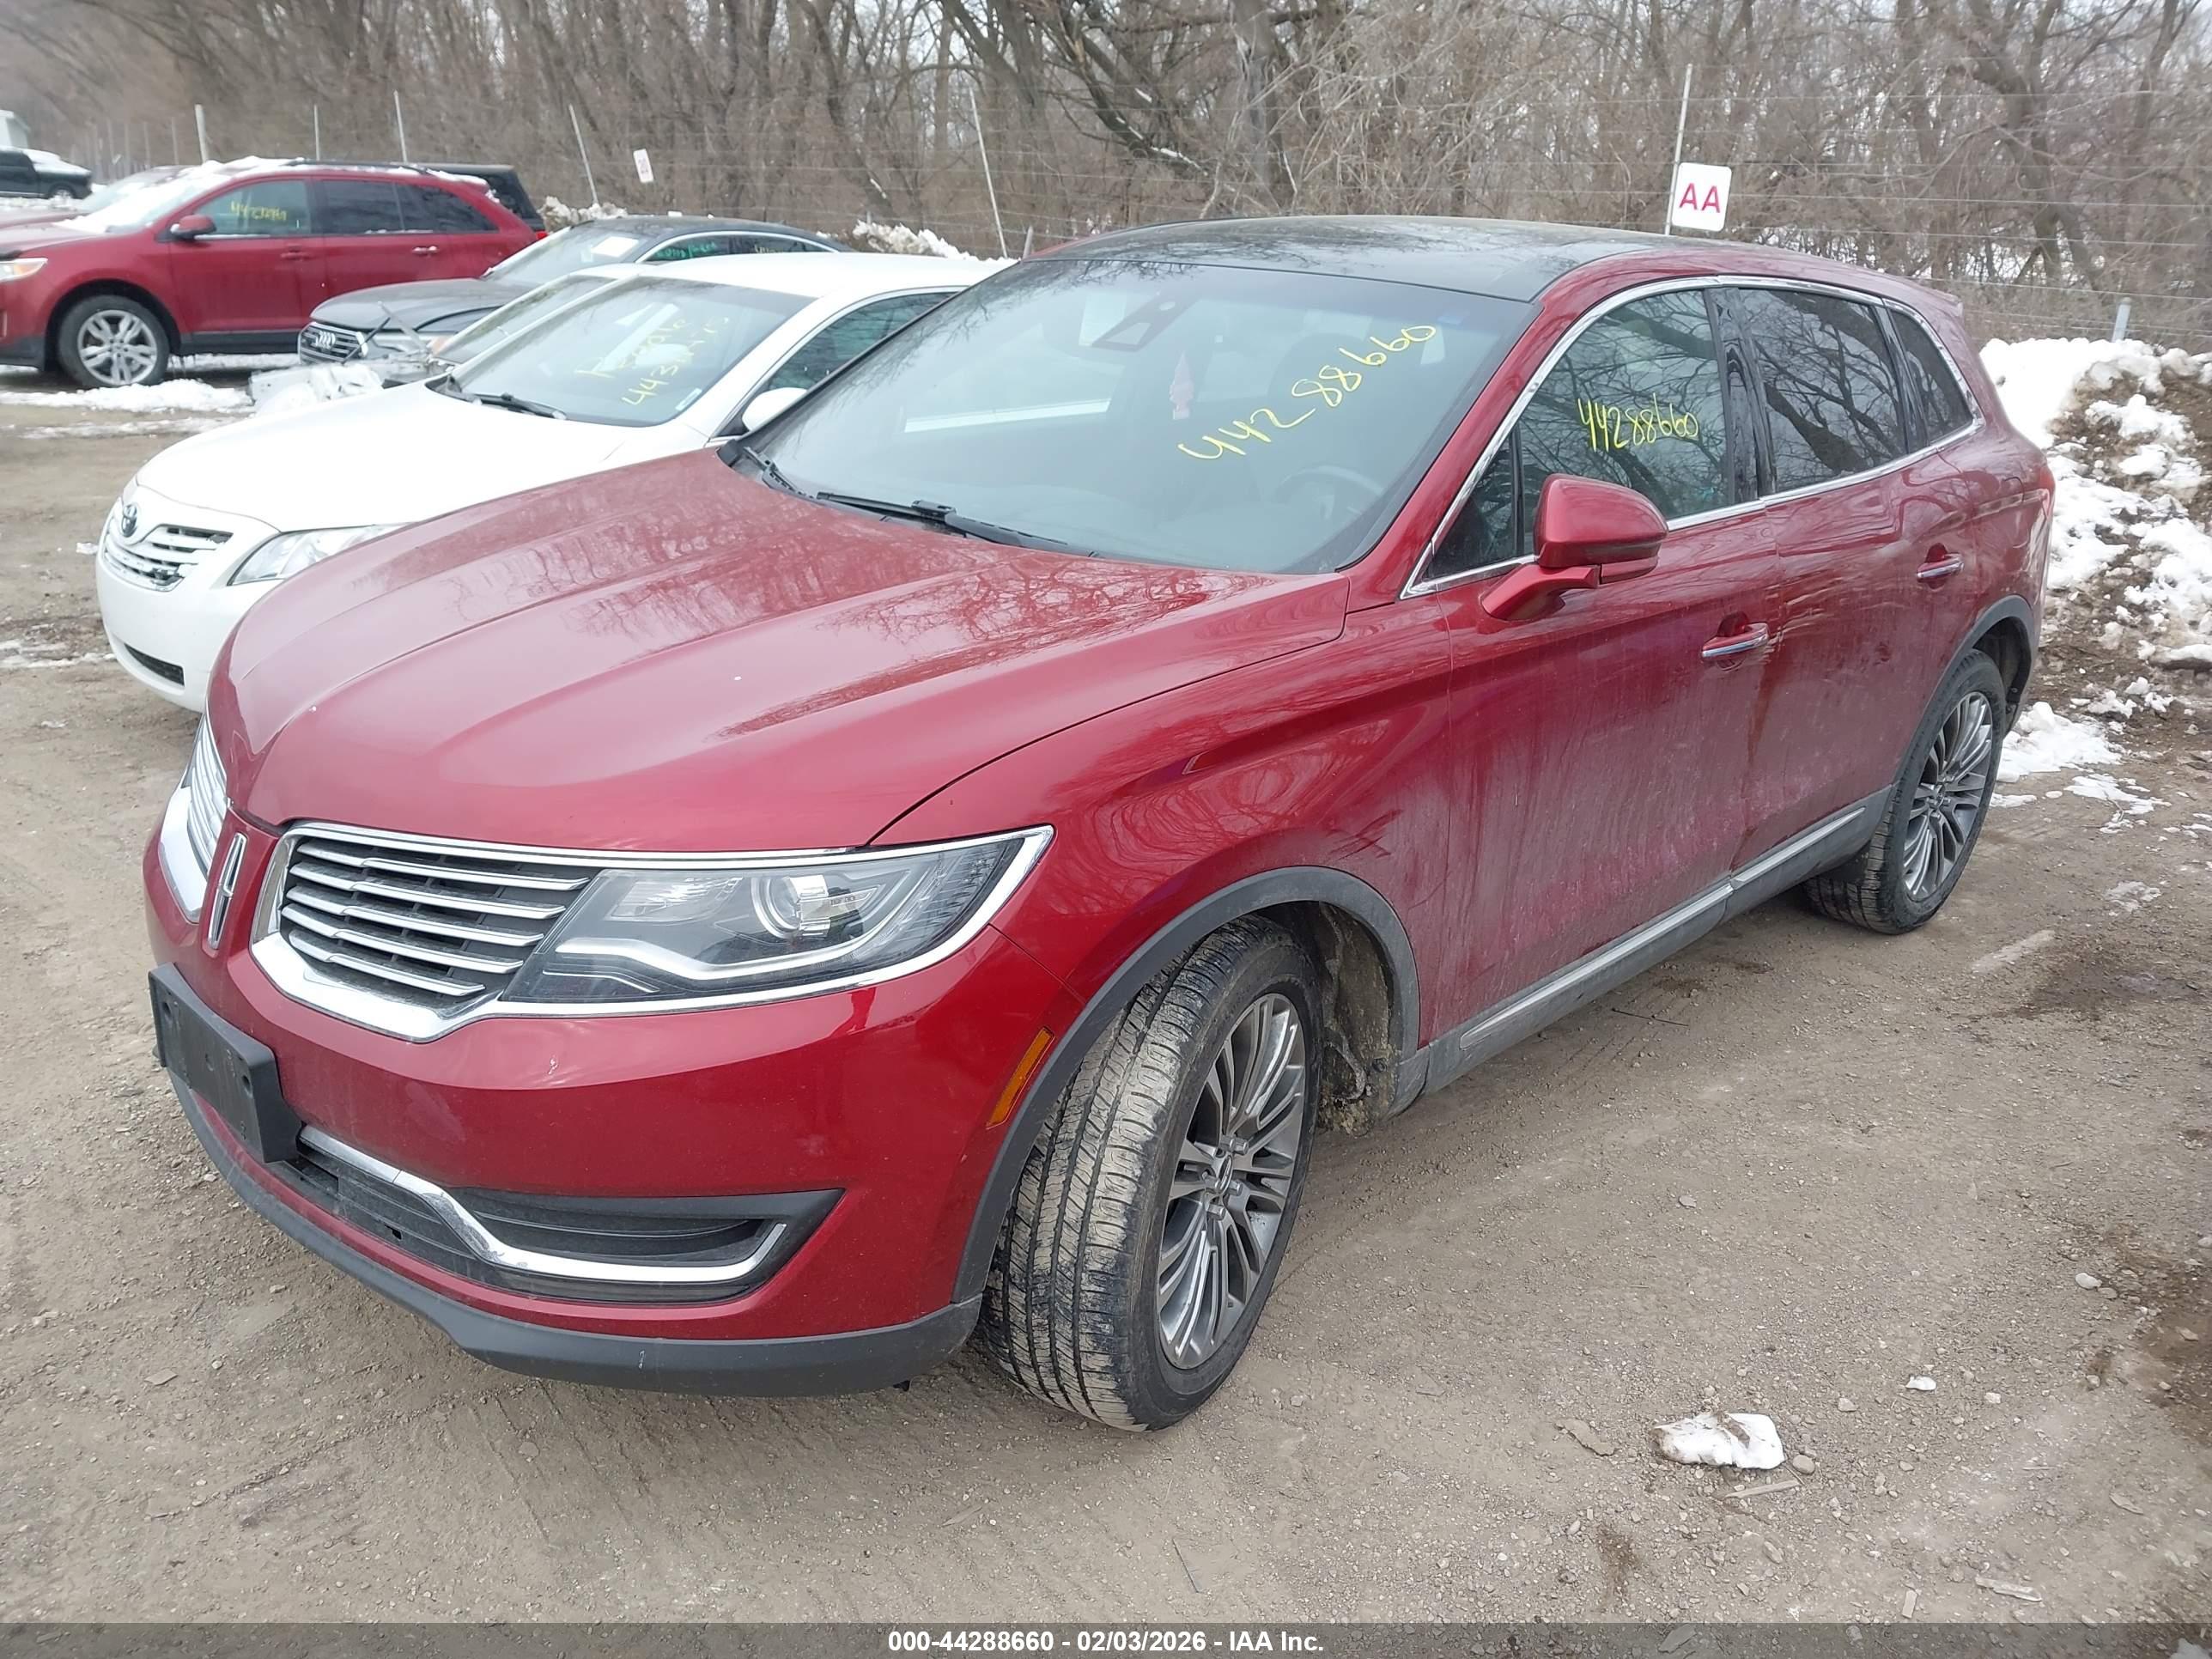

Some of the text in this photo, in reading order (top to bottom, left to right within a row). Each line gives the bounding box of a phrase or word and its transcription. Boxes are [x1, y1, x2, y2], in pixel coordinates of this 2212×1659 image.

[1679, 182, 1721, 214] AA
[1177, 325, 1437, 459] 44288660
[1577, 392, 1699, 453] 44288660
